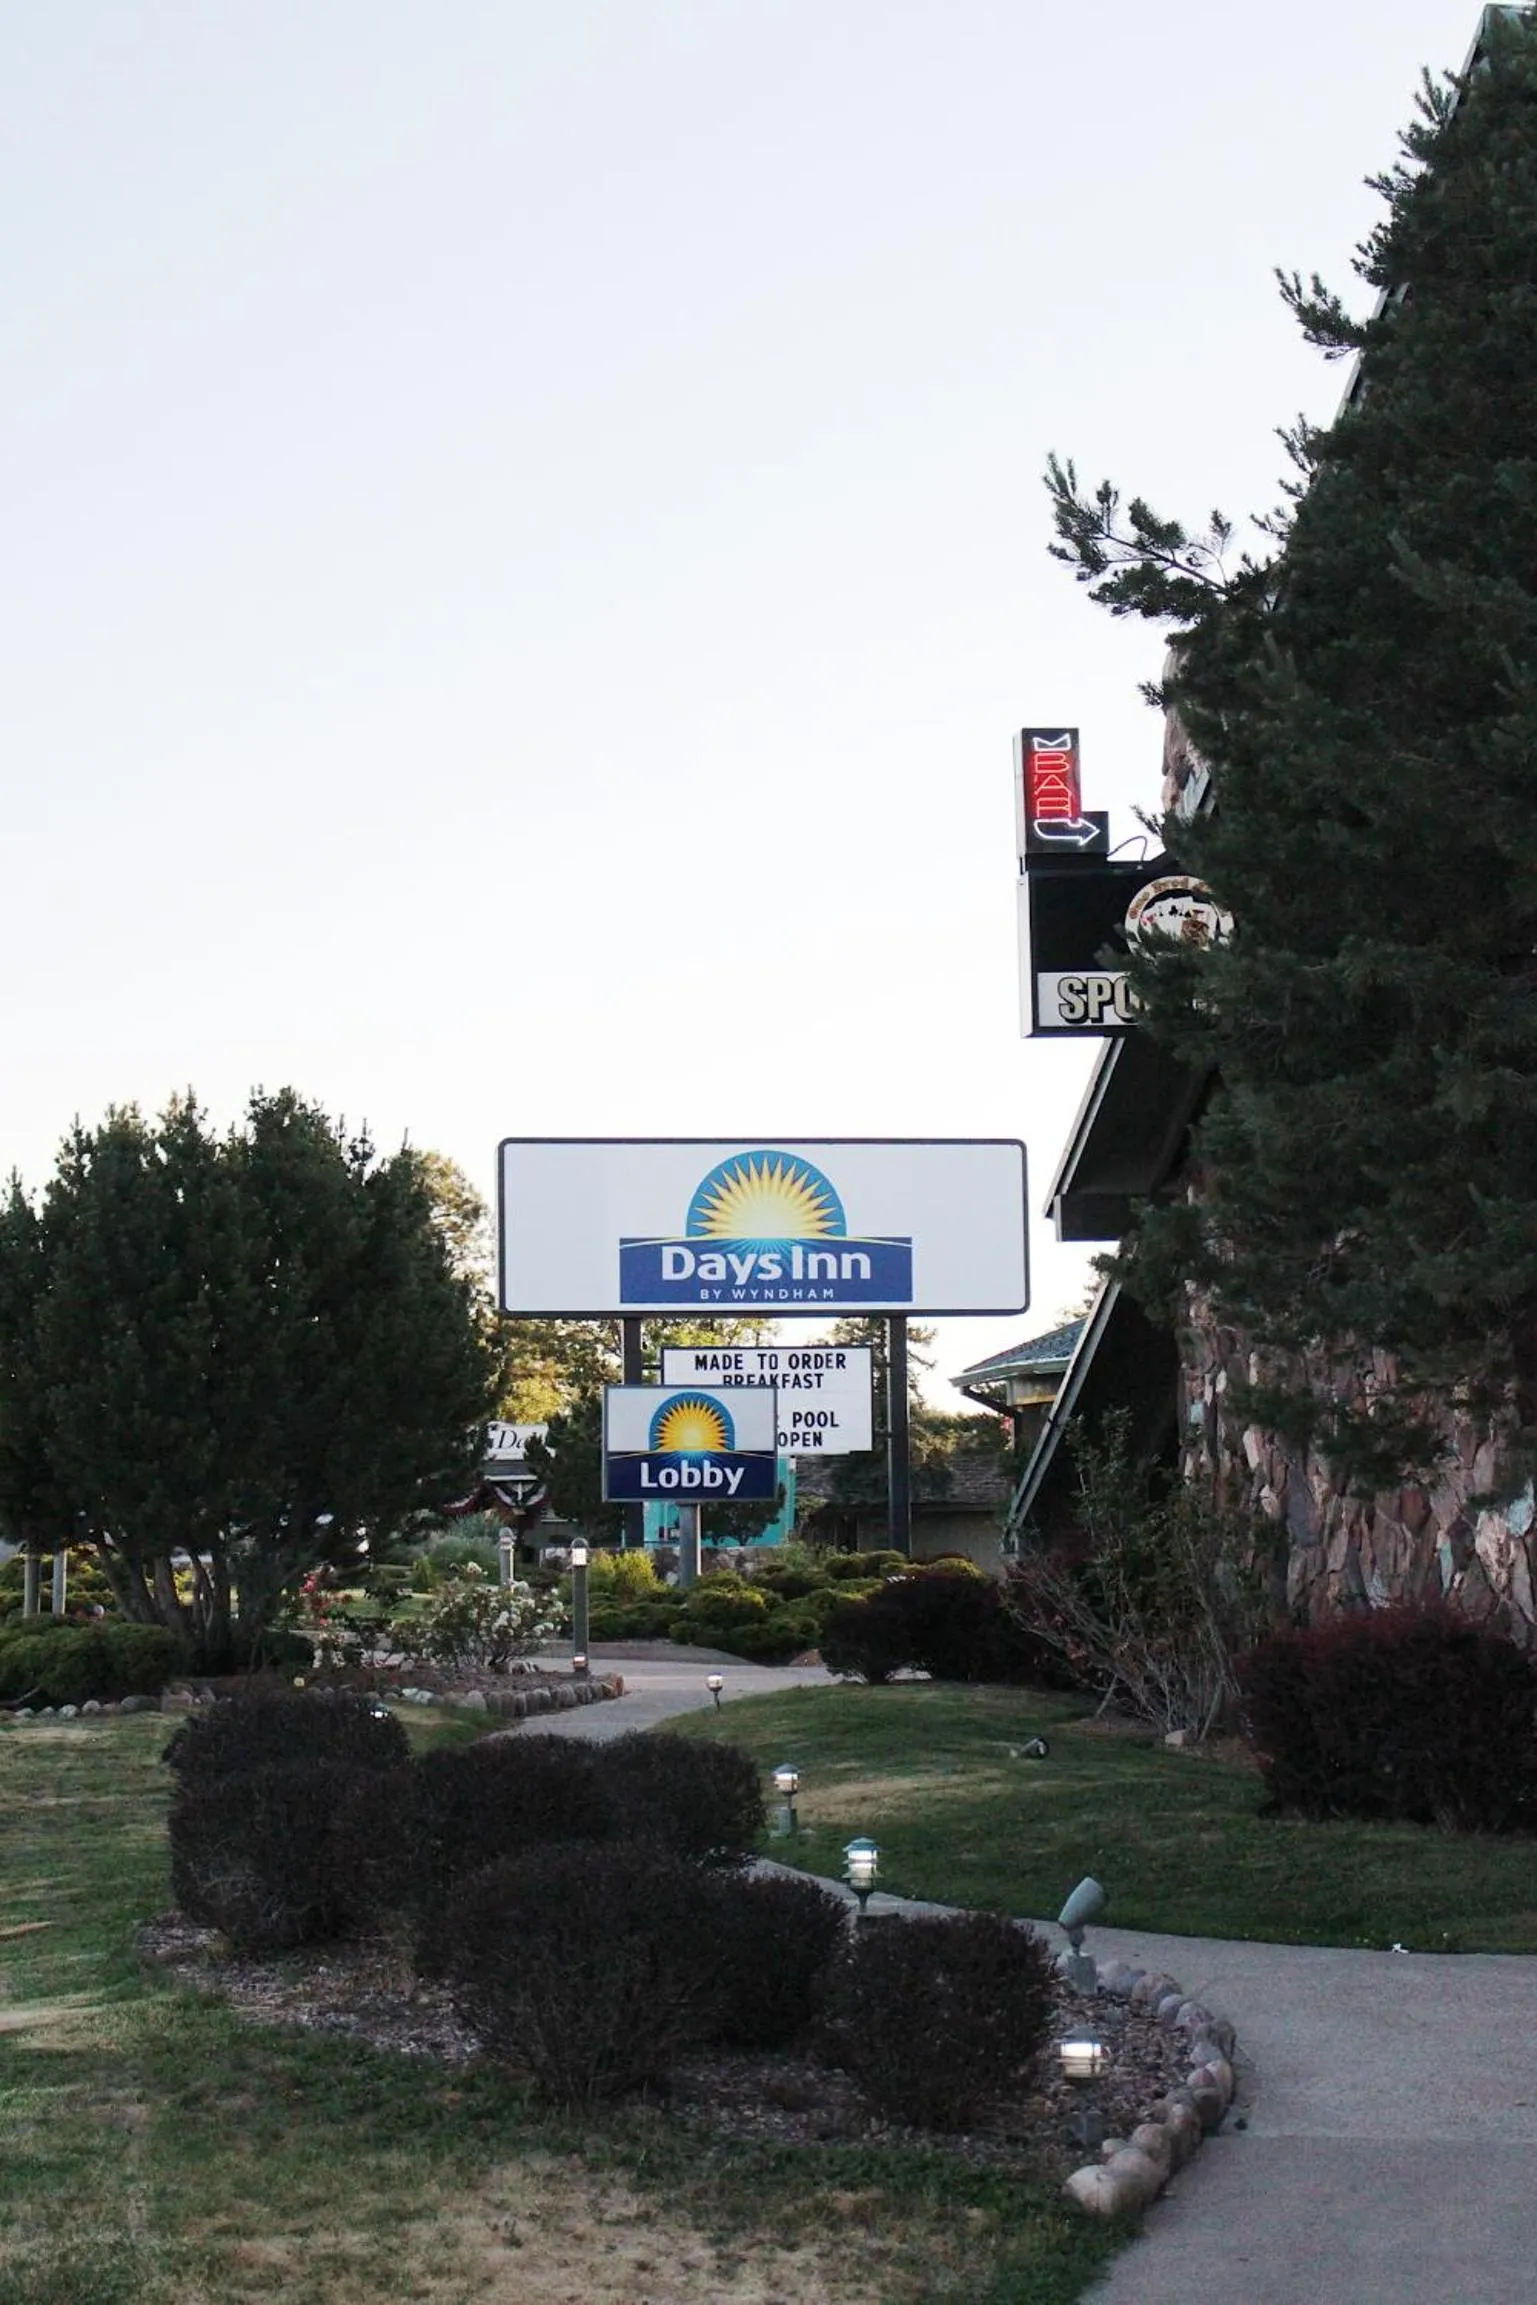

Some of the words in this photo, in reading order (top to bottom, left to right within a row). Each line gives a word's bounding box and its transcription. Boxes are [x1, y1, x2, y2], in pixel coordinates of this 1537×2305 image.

[1034, 753, 1073, 818] BAR
[1057, 975, 1140, 1025] SPO
[662, 1245, 783, 1286] Days
[792, 1245, 871, 1281] Inn
[700, 1288, 723, 1301] BY
[732, 1288, 835, 1301] WYNDHAM
[694, 1354, 744, 1371] MADE
[757, 1353, 778, 1370] TO
[788, 1353, 846, 1370] ORDER
[722, 1373, 824, 1389] BREAKFAST
[792, 1411, 840, 1428] POOL
[777, 1432, 823, 1448] OPEN
[640, 1459, 745, 1495] Lobby
